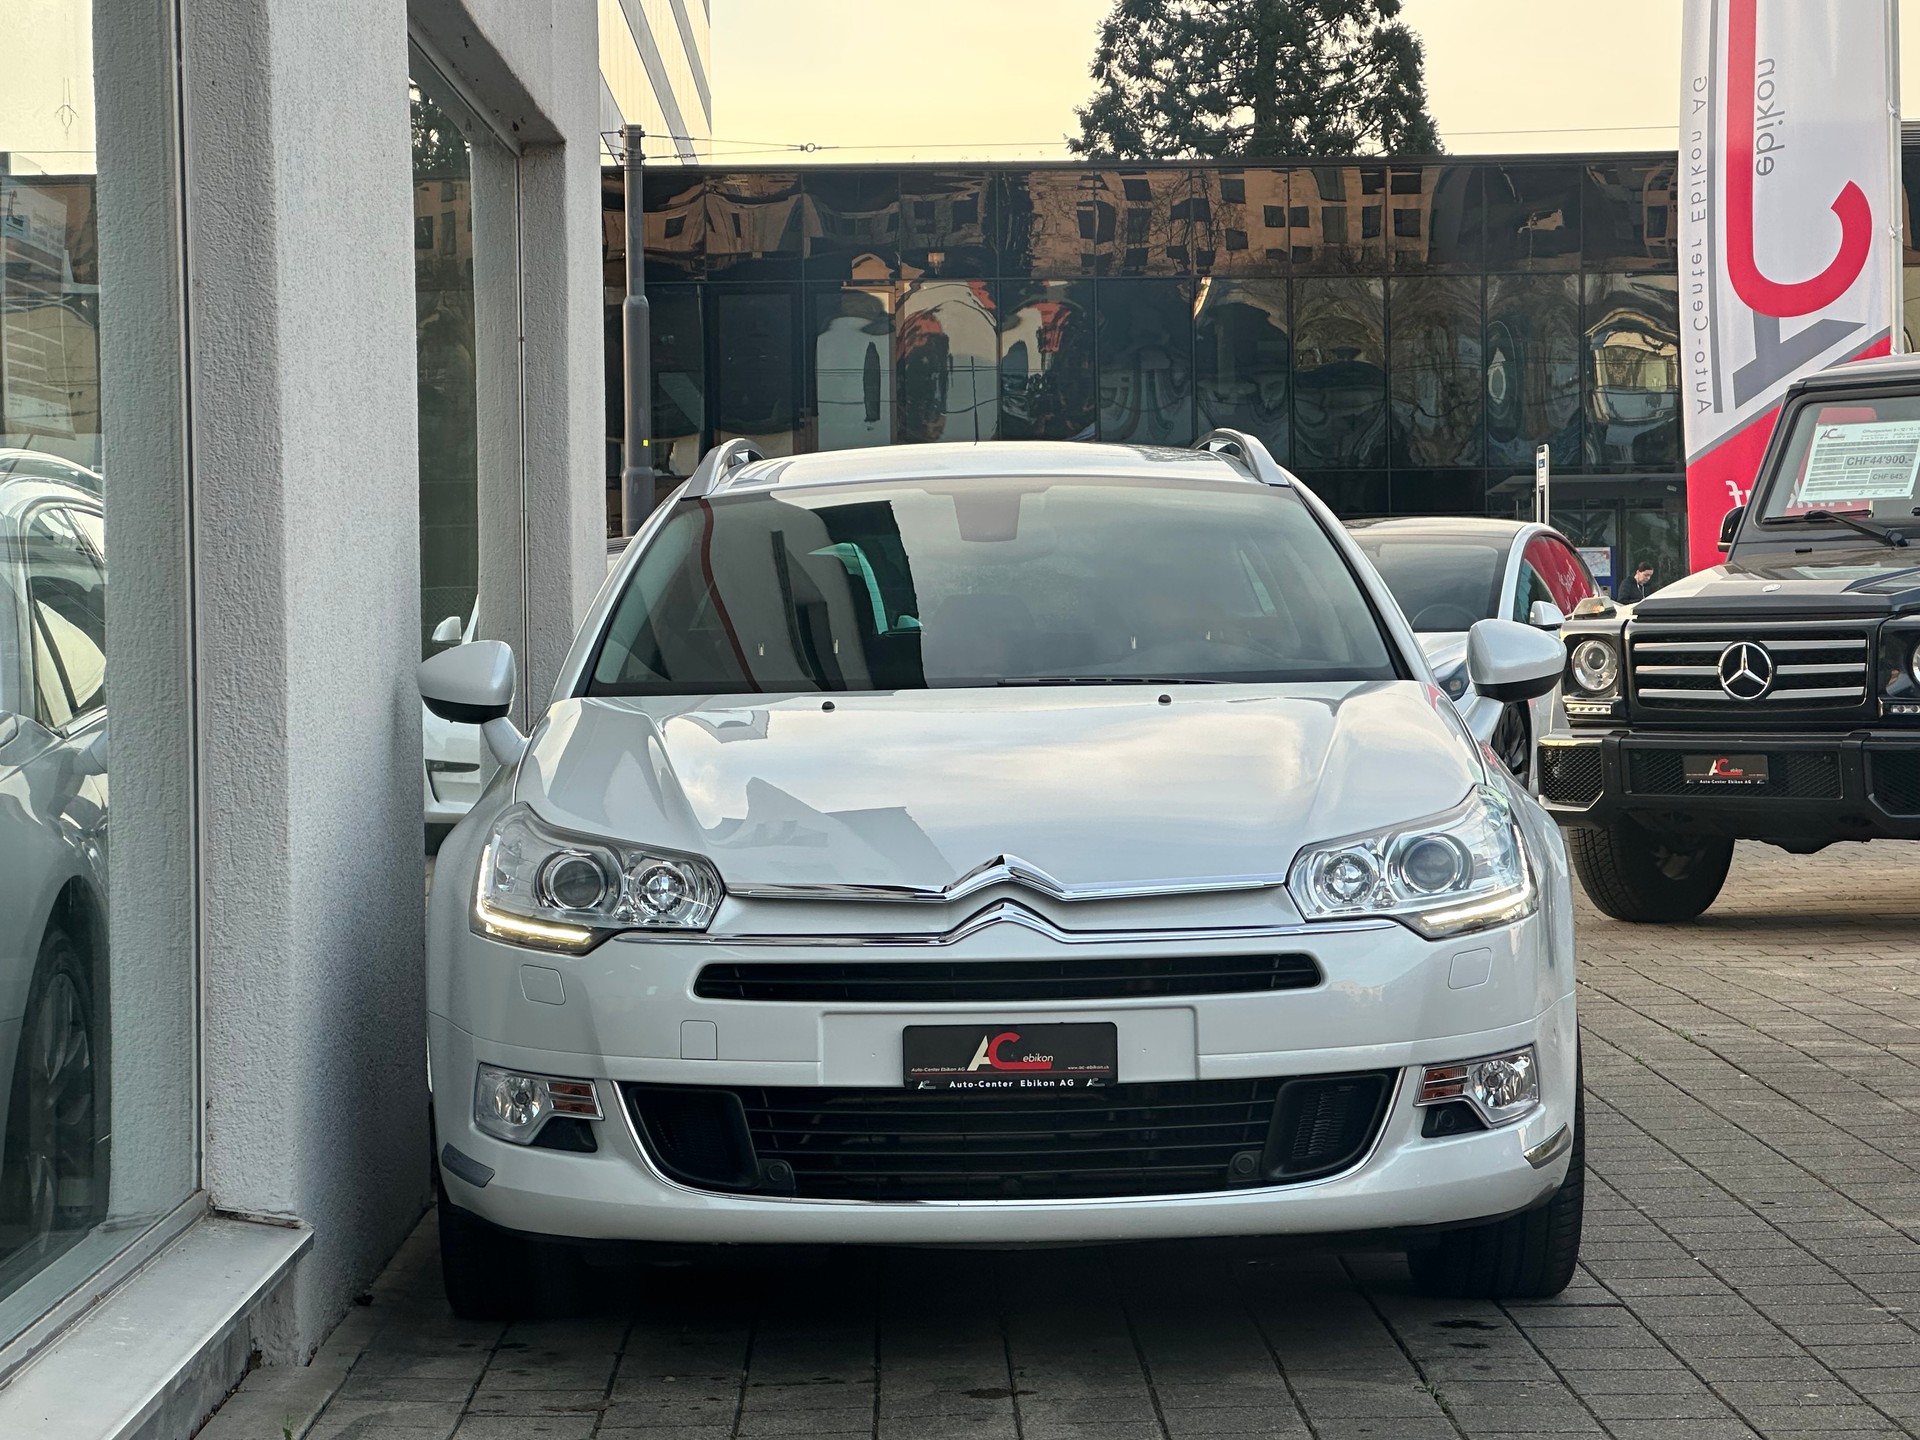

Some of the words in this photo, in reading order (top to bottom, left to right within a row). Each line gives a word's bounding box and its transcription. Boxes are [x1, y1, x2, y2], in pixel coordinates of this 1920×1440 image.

[966, 1032, 1052, 1072] AC
[1022, 1053, 1054, 1063] ebikon
[949, 1080, 1013, 1088] Auto-Center
[1020, 1079, 1055, 1087] Ebikon
[1059, 1079, 1075, 1087] AG
